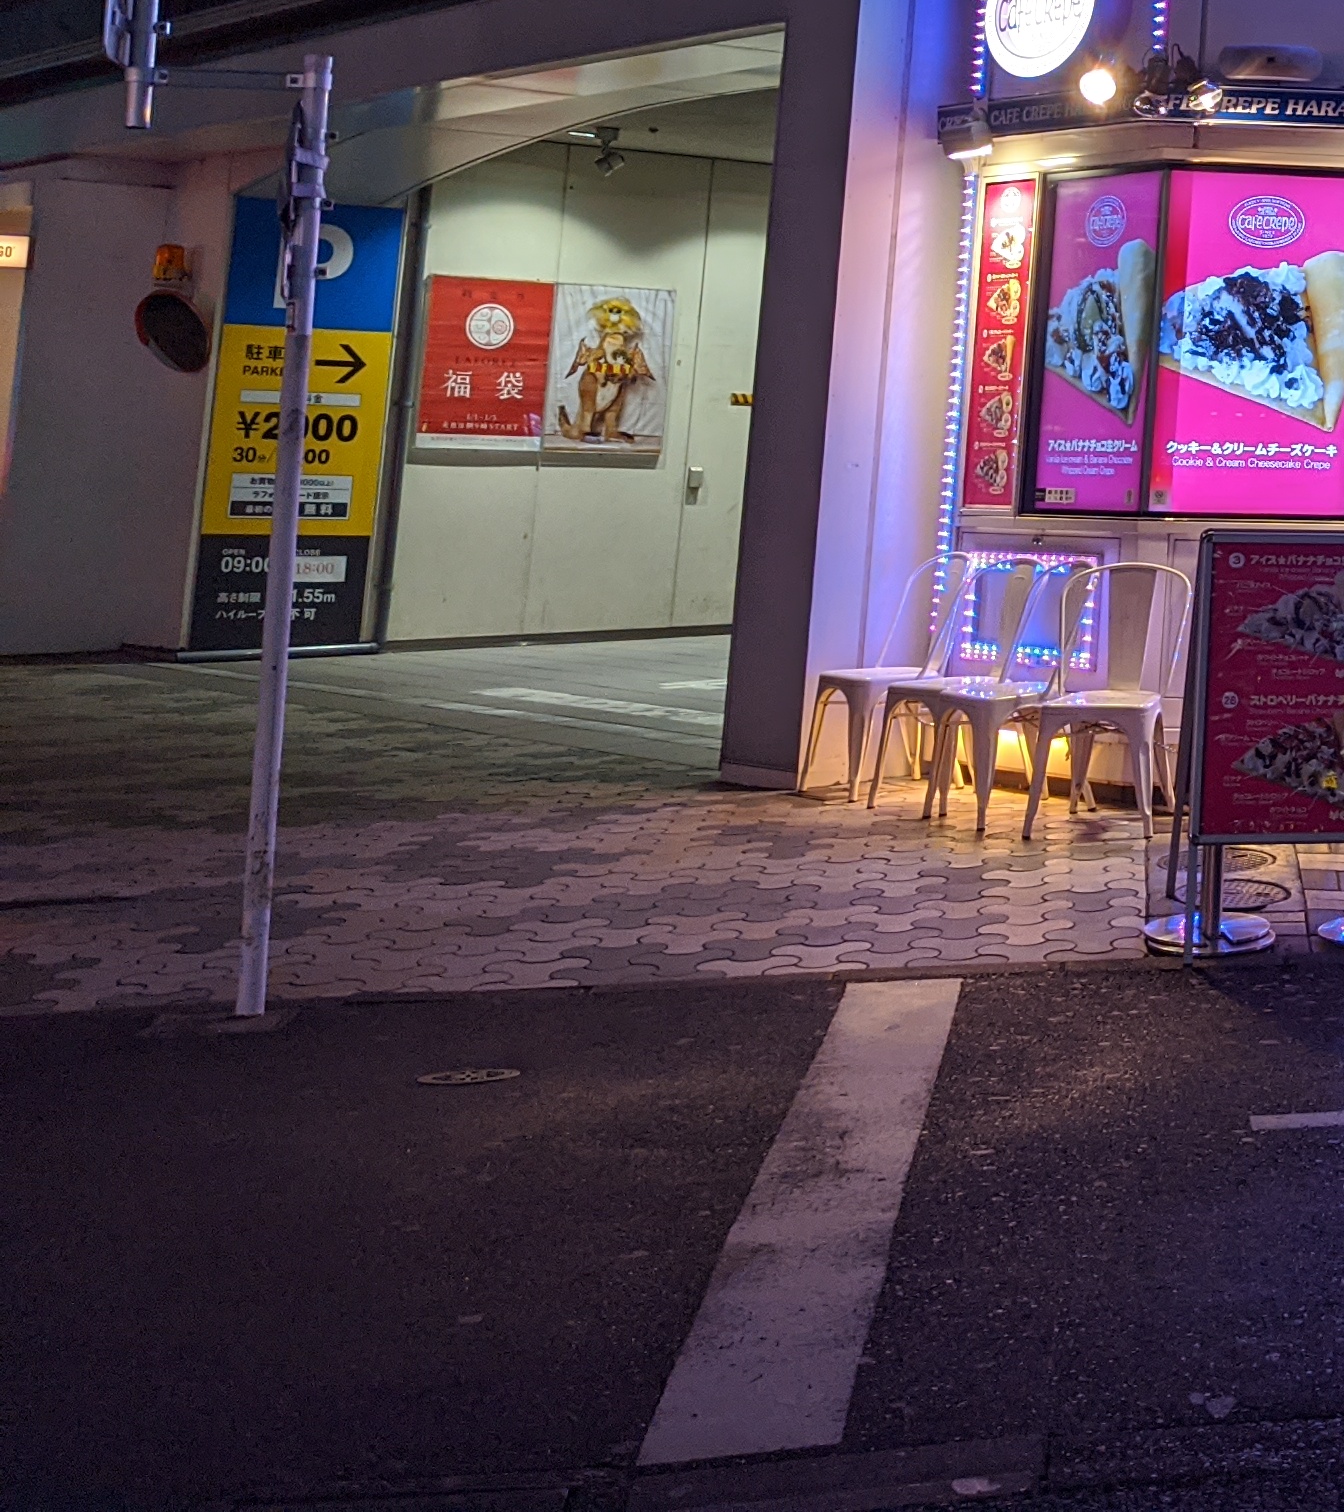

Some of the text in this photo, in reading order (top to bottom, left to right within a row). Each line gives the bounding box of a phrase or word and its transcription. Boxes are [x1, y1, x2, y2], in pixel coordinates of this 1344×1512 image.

[989, 104, 1021, 126] CAFE
[1022, 101, 1061, 123] CREPE
[1220, 97, 1281, 116] REPE
[440, 369, 524, 400] 福袋
[235, 409, 359, 443] ¥200
[1165, 439, 1338, 457] クッキー&クリームチーズケーキ
[1172, 456, 1204, 467] Cookie
[1215, 458, 1246, 468] Cream
[1247, 458, 1302, 469] Cheesecake
